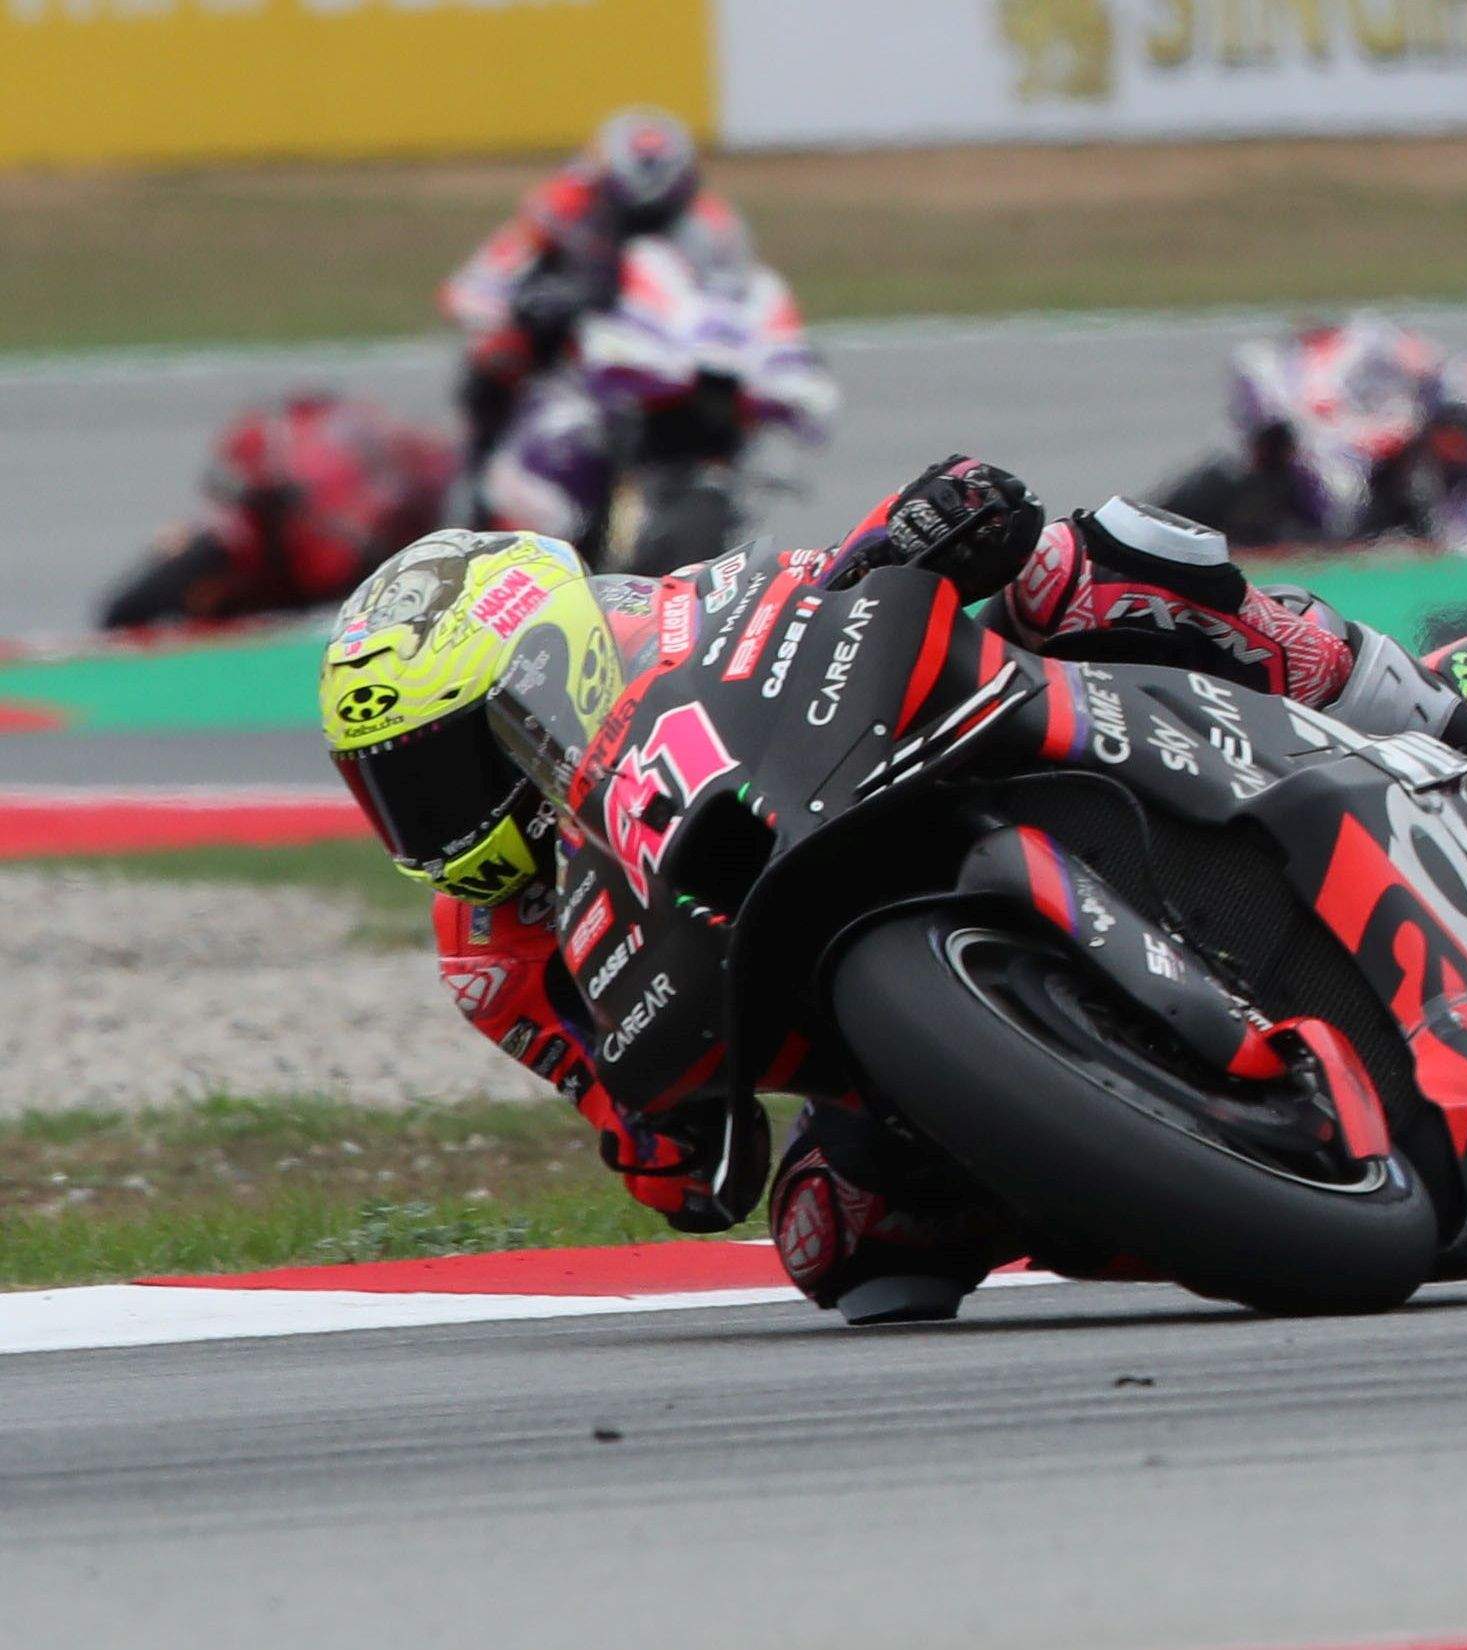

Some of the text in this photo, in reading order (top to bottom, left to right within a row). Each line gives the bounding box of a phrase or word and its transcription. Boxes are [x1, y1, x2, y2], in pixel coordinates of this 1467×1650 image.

[761, 621, 807, 698] CASE
[807, 597, 881, 726] CAREAR
[588, 941, 630, 1001] CASE
[603, 972, 677, 1063] CAREAR
